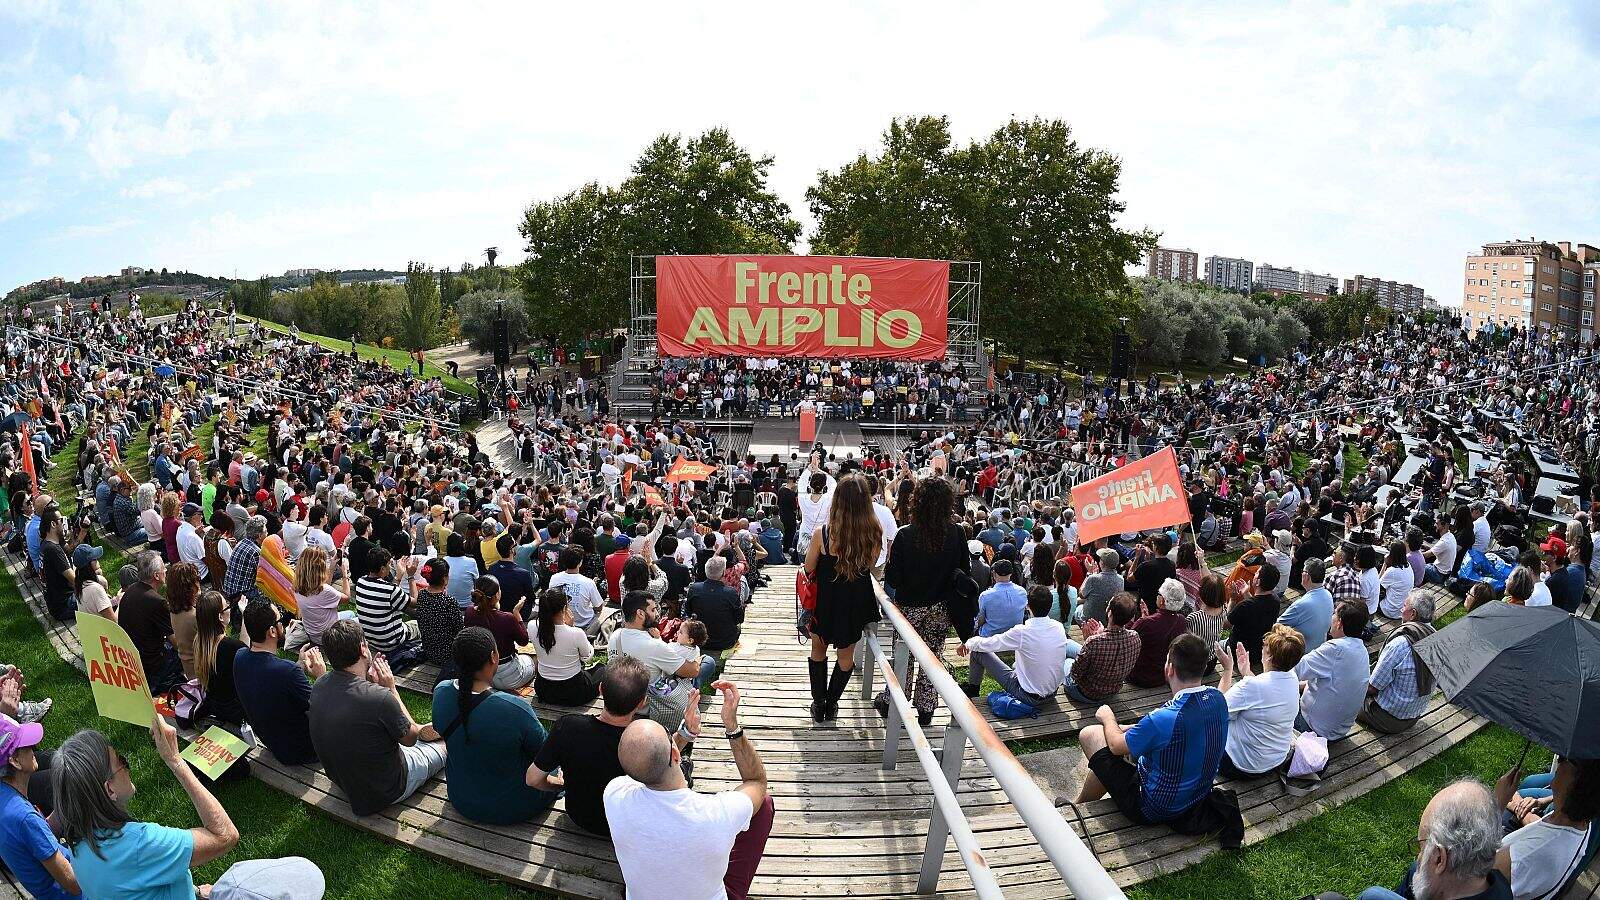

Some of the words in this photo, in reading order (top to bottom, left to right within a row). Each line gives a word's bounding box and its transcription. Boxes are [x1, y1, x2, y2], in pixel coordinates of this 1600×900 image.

[735, 261, 872, 305] Frente
[682, 306, 923, 349] AMPLIO
[90, 659, 145, 692] AMP
[193, 745, 220, 767] Frente
[194, 735, 238, 764] AMPLIO
